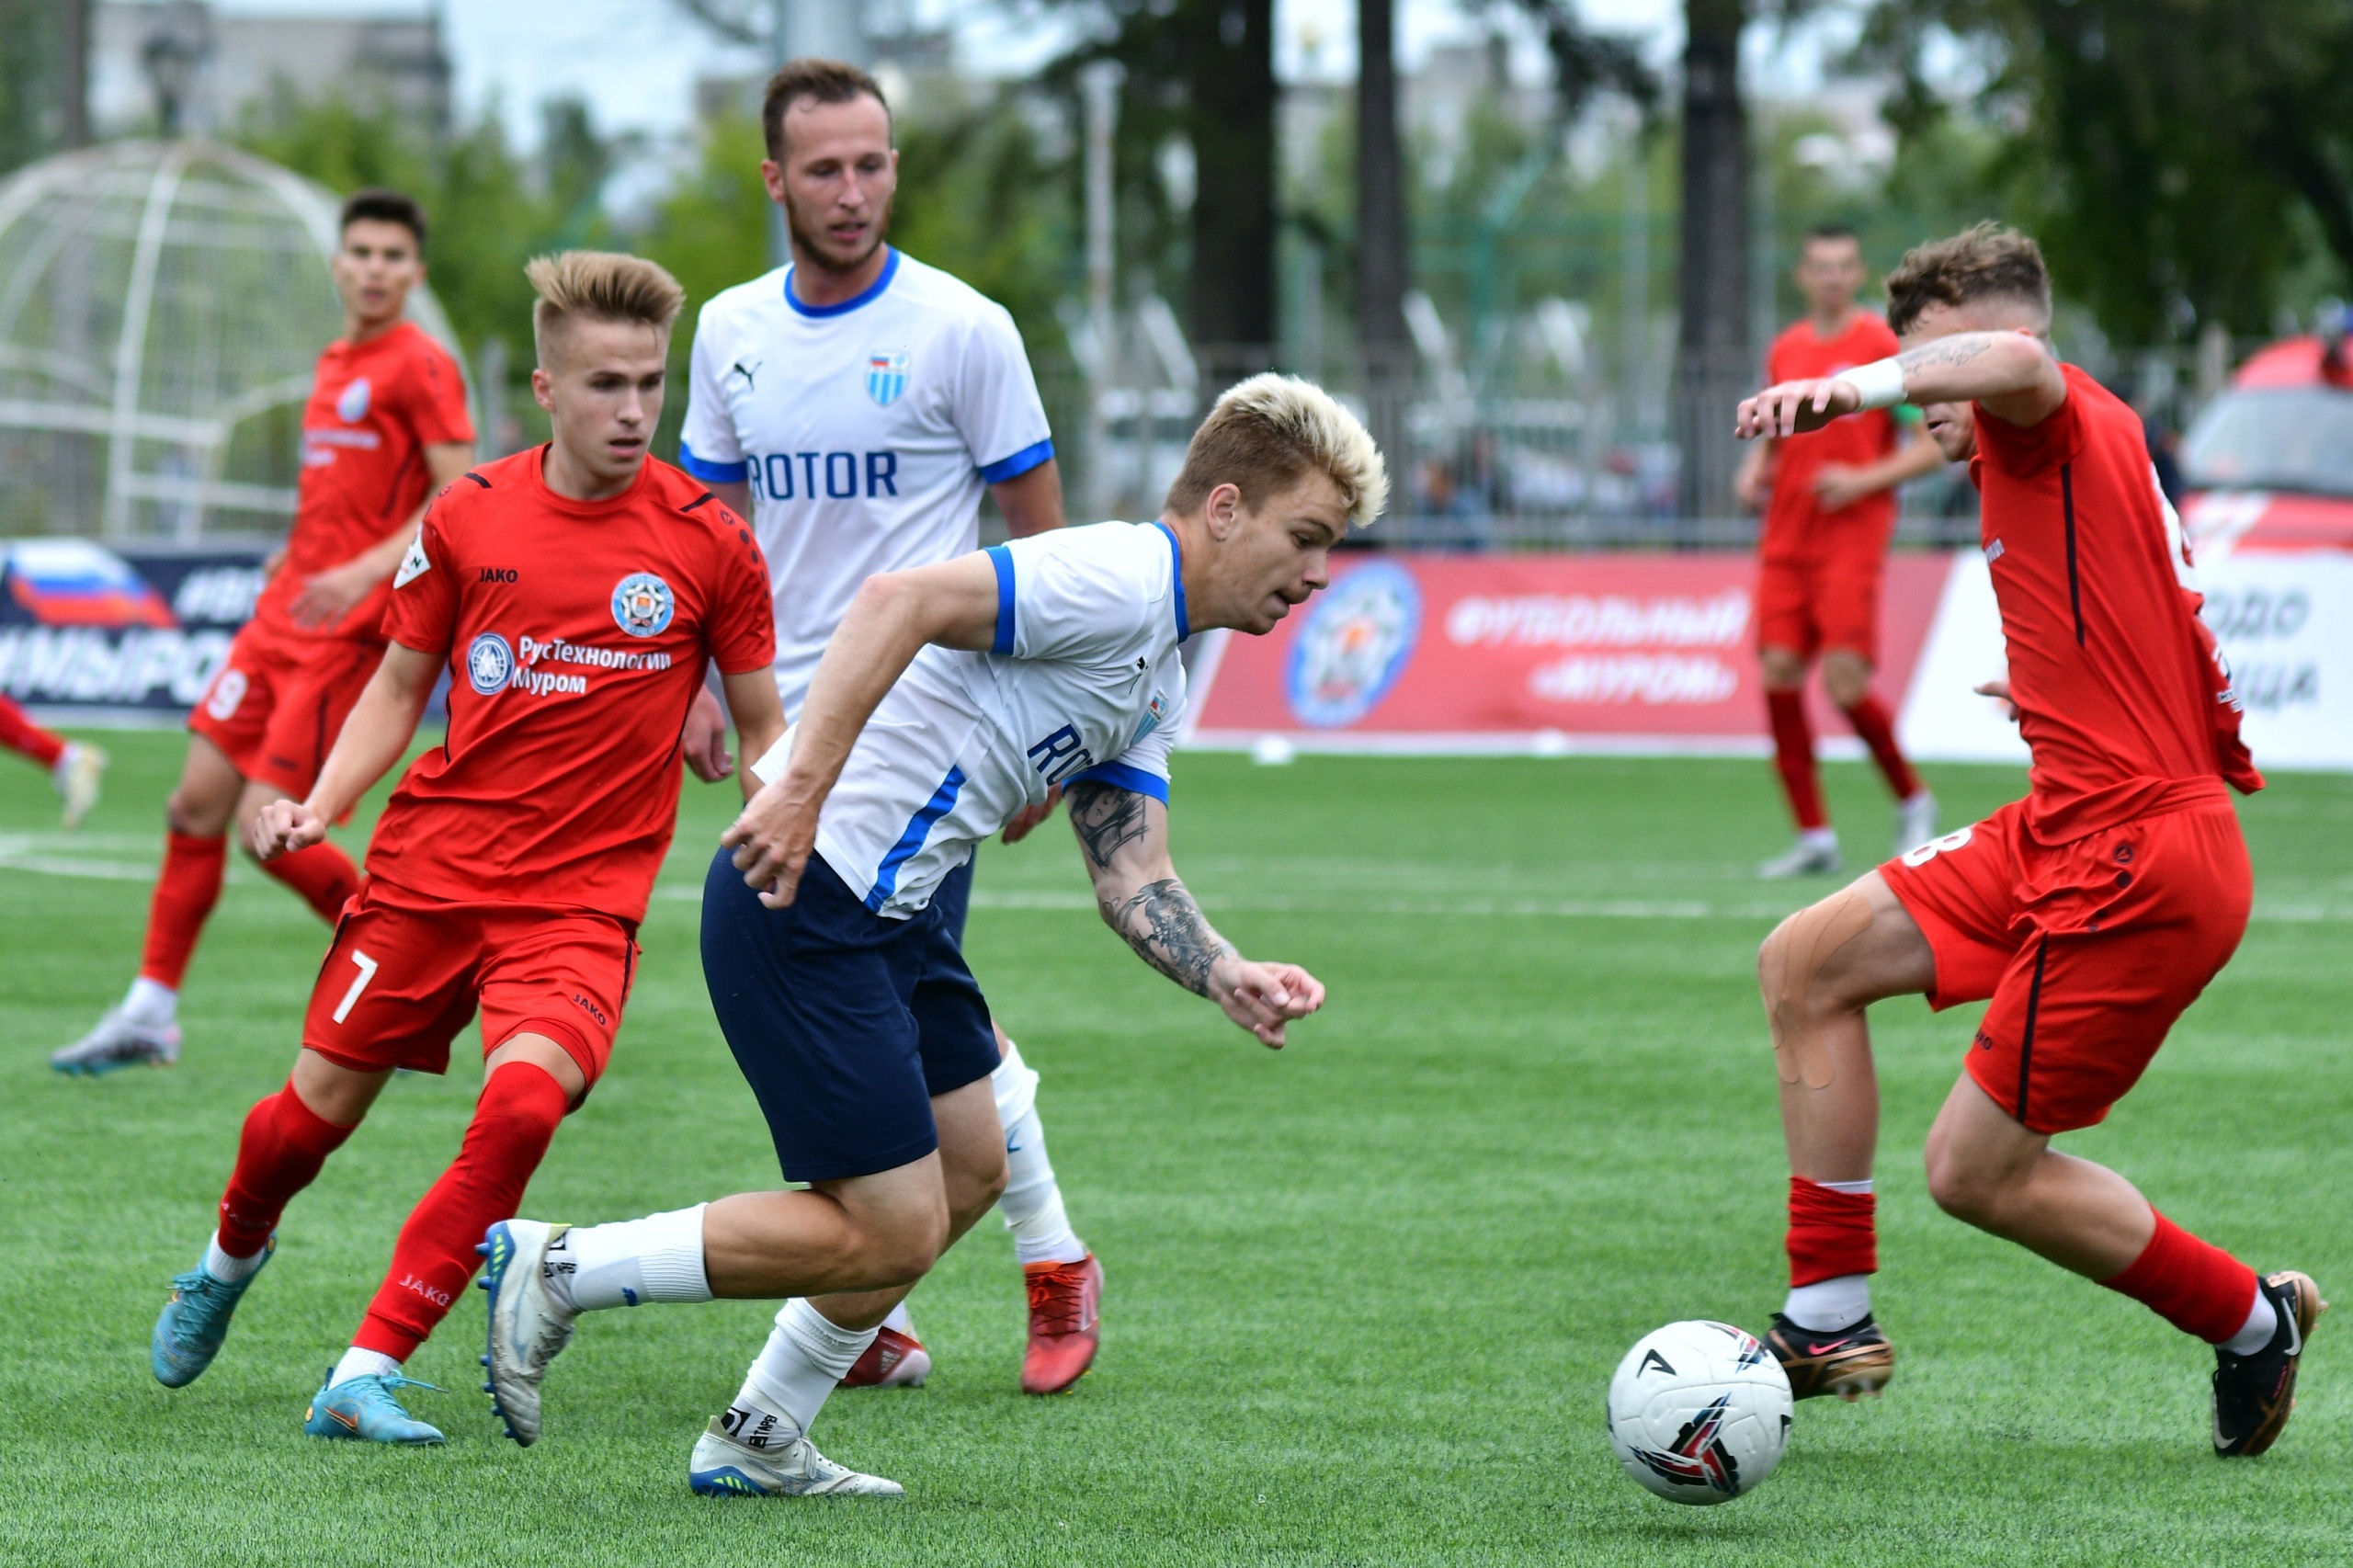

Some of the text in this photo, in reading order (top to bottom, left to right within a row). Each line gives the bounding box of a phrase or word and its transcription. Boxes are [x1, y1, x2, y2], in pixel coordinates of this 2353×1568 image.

[745, 451, 898, 501] ROTOR
[479, 568, 518, 584] JAKO
[1445, 586, 1752, 648] ФУТБОЛЬНЫЙ
[518, 636, 671, 670] РусТехнологии
[207, 669, 248, 721] 9
[511, 666, 586, 697] Муром
[332, 948, 379, 1025] 7
[573, 994, 607, 1027] JAKO
[398, 1274, 449, 1307] JAKO
